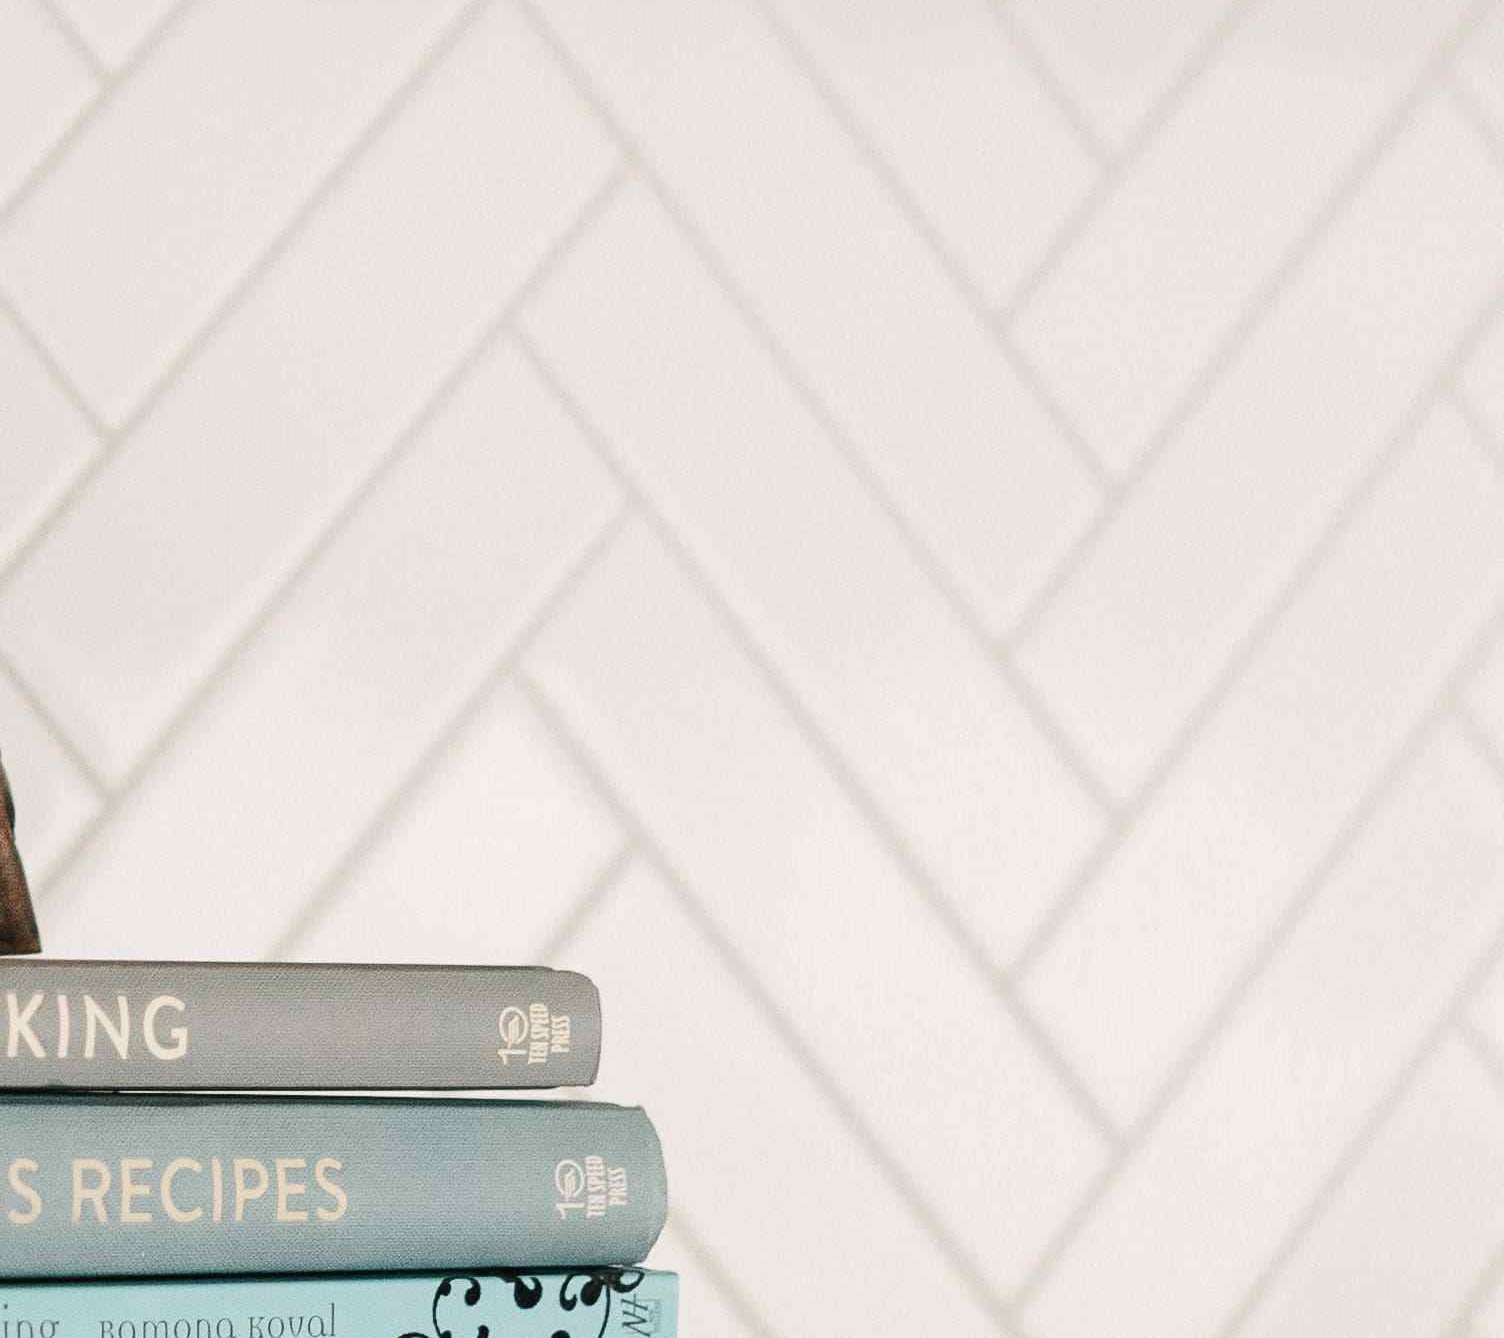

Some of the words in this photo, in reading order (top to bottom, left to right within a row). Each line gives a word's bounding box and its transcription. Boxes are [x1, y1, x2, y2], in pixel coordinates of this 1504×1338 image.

[528, 1003, 550, 1040] SPEED
[551, 1014, 571, 1054] PRESS
[527, 1042, 549, 1065] TEN
[70, 1156, 350, 1225] RECIPES
[585, 1155, 607, 1192] SPEED
[607, 1166, 628, 1206] PRESS
[586, 1194, 608, 1219] TEN
